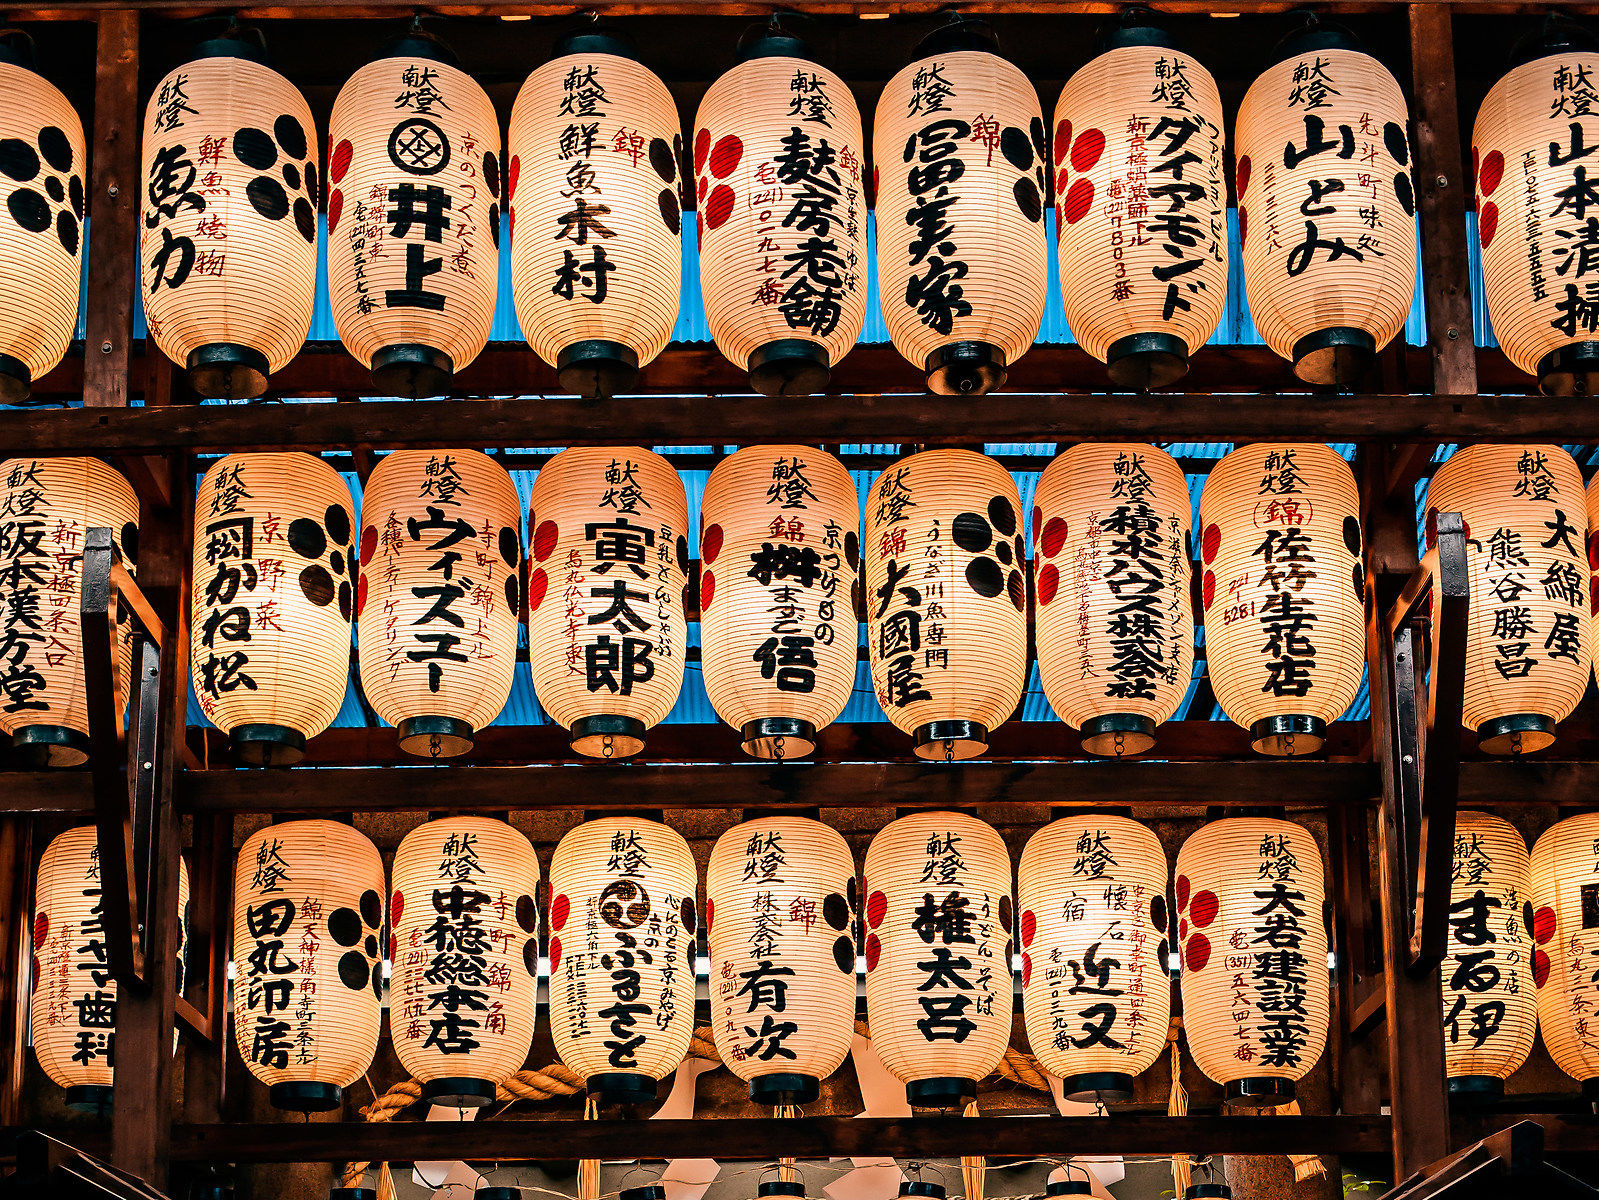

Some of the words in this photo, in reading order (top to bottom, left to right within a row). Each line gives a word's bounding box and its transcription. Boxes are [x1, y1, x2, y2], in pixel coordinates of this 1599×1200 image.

[450, 131, 479, 280] 京のつくだ煮
[611, 127, 646, 168] 錦
[970, 114, 1000, 167] 錦
[1283, 114, 1366, 277] 山とみ
[145, 144, 206, 294] 魚力
[385, 183, 451, 311] 井上
[1145, 114, 1213, 321] ダイアモンド
[255, 512, 285, 632] 京野菜
[768, 515, 805, 543] 錦
[878, 527, 907, 561] 錦
[1102, 505, 1165, 701] 積水ハウス株式会社
[585, 517, 656, 696] 寅太郎
[1252, 527, 1318, 697] 佐竹生花店
[1485, 528, 1539, 681] 熊谷勝昌
[246, 898, 299, 1069] 田丸印房
[422, 886, 492, 1055] 中徳総本店
[789, 896, 817, 935] 錦
[1251, 883, 1310, 1068] 大岩建設工業
[598, 931, 653, 1068] ふるさと
